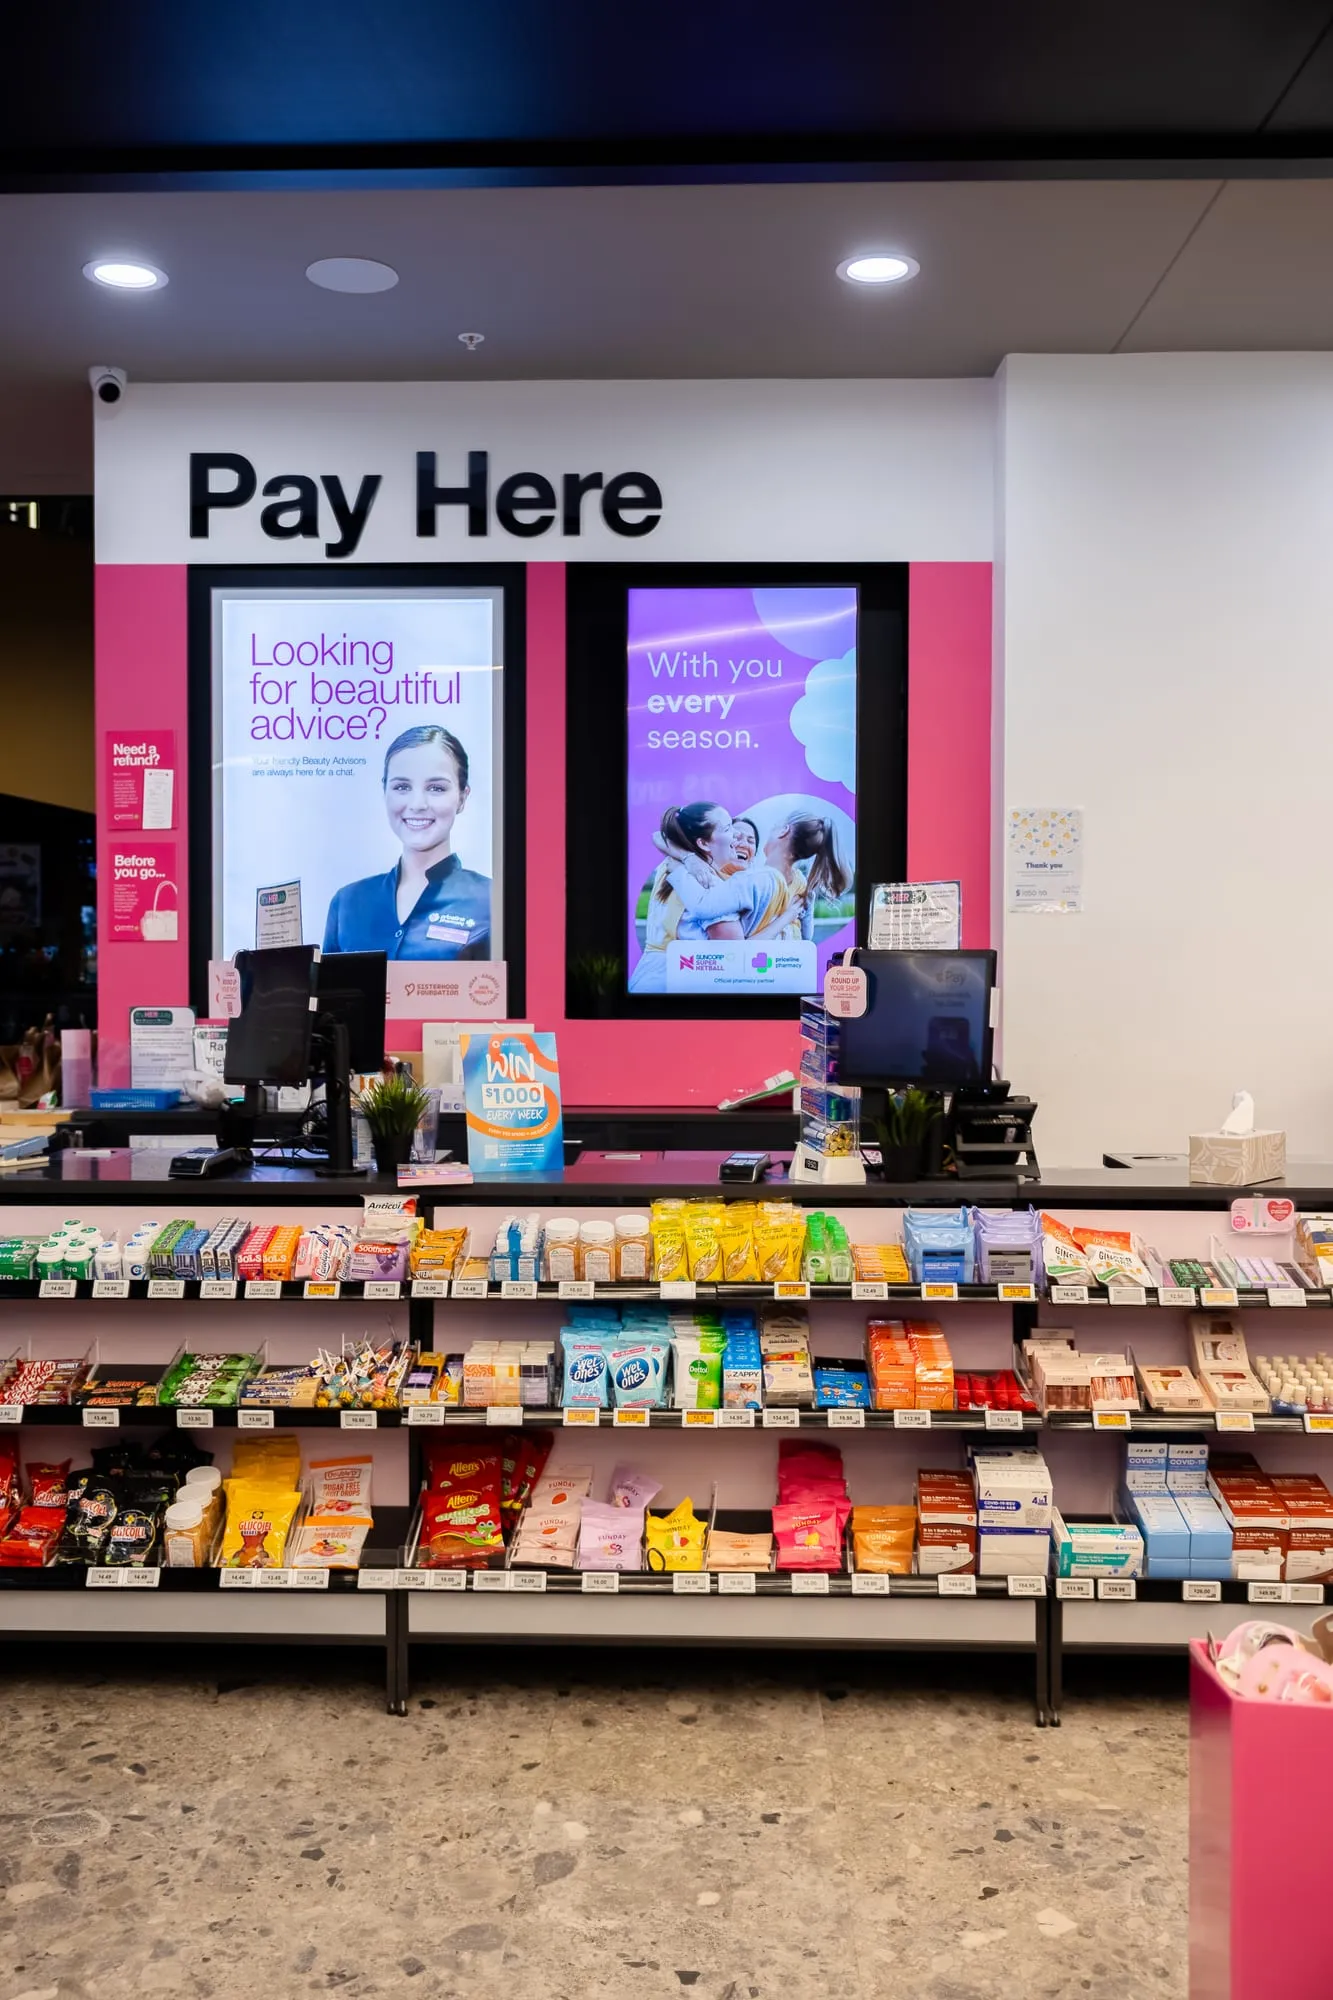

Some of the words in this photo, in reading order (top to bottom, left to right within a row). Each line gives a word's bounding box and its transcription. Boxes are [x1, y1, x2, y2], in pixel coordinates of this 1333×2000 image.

[190, 452, 382, 559] Pay
[416, 450, 663, 539] Here
[251, 632, 394, 675] Looking
[647, 651, 719, 678] With
[728, 658, 783, 684] you
[249, 672, 297, 705] for
[311, 671, 461, 705] beautiful
[647, 693, 736, 720] every
[250, 706, 388, 740] advice?
[647, 729, 760, 749] season.
[113, 743, 146, 755] Need
[148, 745, 157, 755] a
[113, 754, 160, 767] refund?
[302, 756, 331, 766] Beauty
[332, 756, 367, 765] Advisors
[266, 767, 295, 778] always
[295, 767, 314, 776] here
[315, 767, 327, 776] for
[335, 767, 356, 776] chat.
[114, 854, 155, 867] Before
[114, 868, 137, 880] you
[139, 868, 166, 880] go...
[831, 977, 850, 985] ROUND
[851, 977, 860, 985] UP
[486, 1052, 536, 1083] WIN
[486, 1109, 515, 1121] EVERY
[517, 1109, 543, 1120] WEEK
[358, 1244, 393, 1254] Soothers
[22, 1360, 56, 1375] KitKat
[689, 1366, 708, 1374] Dettol
[621, 1369, 646, 1388] ones
[449, 1461, 480, 1475] Allen's
[323, 1483, 345, 1491] SUGAR
[345, 1481, 361, 1489] FREE
[548, 1480, 577, 1489] FUNDAY
[340, 1489, 361, 1497] DROPS
[446, 1494, 478, 1509] Allen's
[238, 1520, 273, 1531] GLUCOJEL
[539, 1518, 569, 1527] FUNDAY
[791, 1519, 821, 1529] FUNDAY
[597, 1534, 628, 1542] FUNDAY
[865, 1533, 897, 1544] FUNDAY
